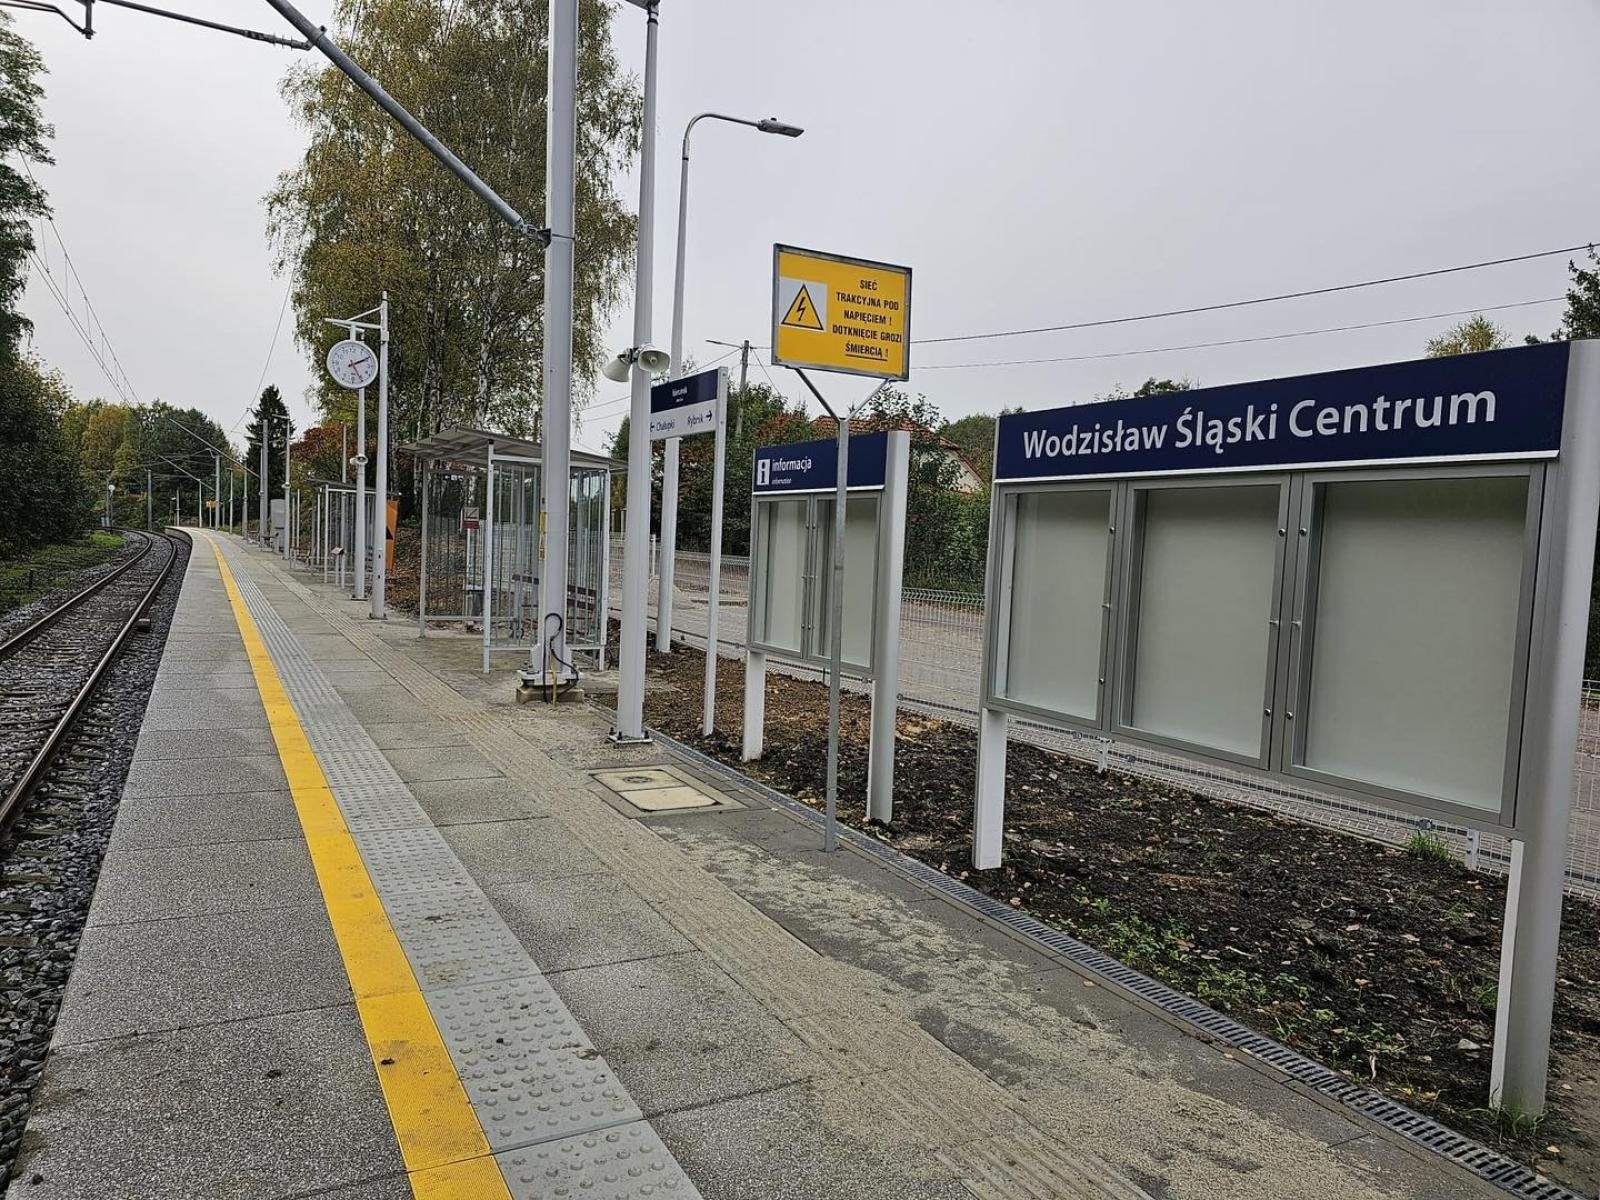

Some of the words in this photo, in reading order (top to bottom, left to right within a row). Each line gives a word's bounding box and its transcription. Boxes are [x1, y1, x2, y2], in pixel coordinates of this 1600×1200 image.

[860, 279, 878, 291] SIEĆ
[836, 291, 881, 308] TRAKCYJNA
[884, 300, 899, 311] POD
[843, 310, 886, 325] NAPIĘCIEM
[832, 325, 878, 340] DOTKNIĘCIE
[880, 332, 902, 343] GROZI
[845, 340, 883, 358] ŚMIERCIĄ
[1023, 420, 1167, 459] Wodzisław
[1174, 403, 1277, 454] Śląski
[1288, 390, 1496, 438] Centrum
[772, 456, 812, 473] informacja
